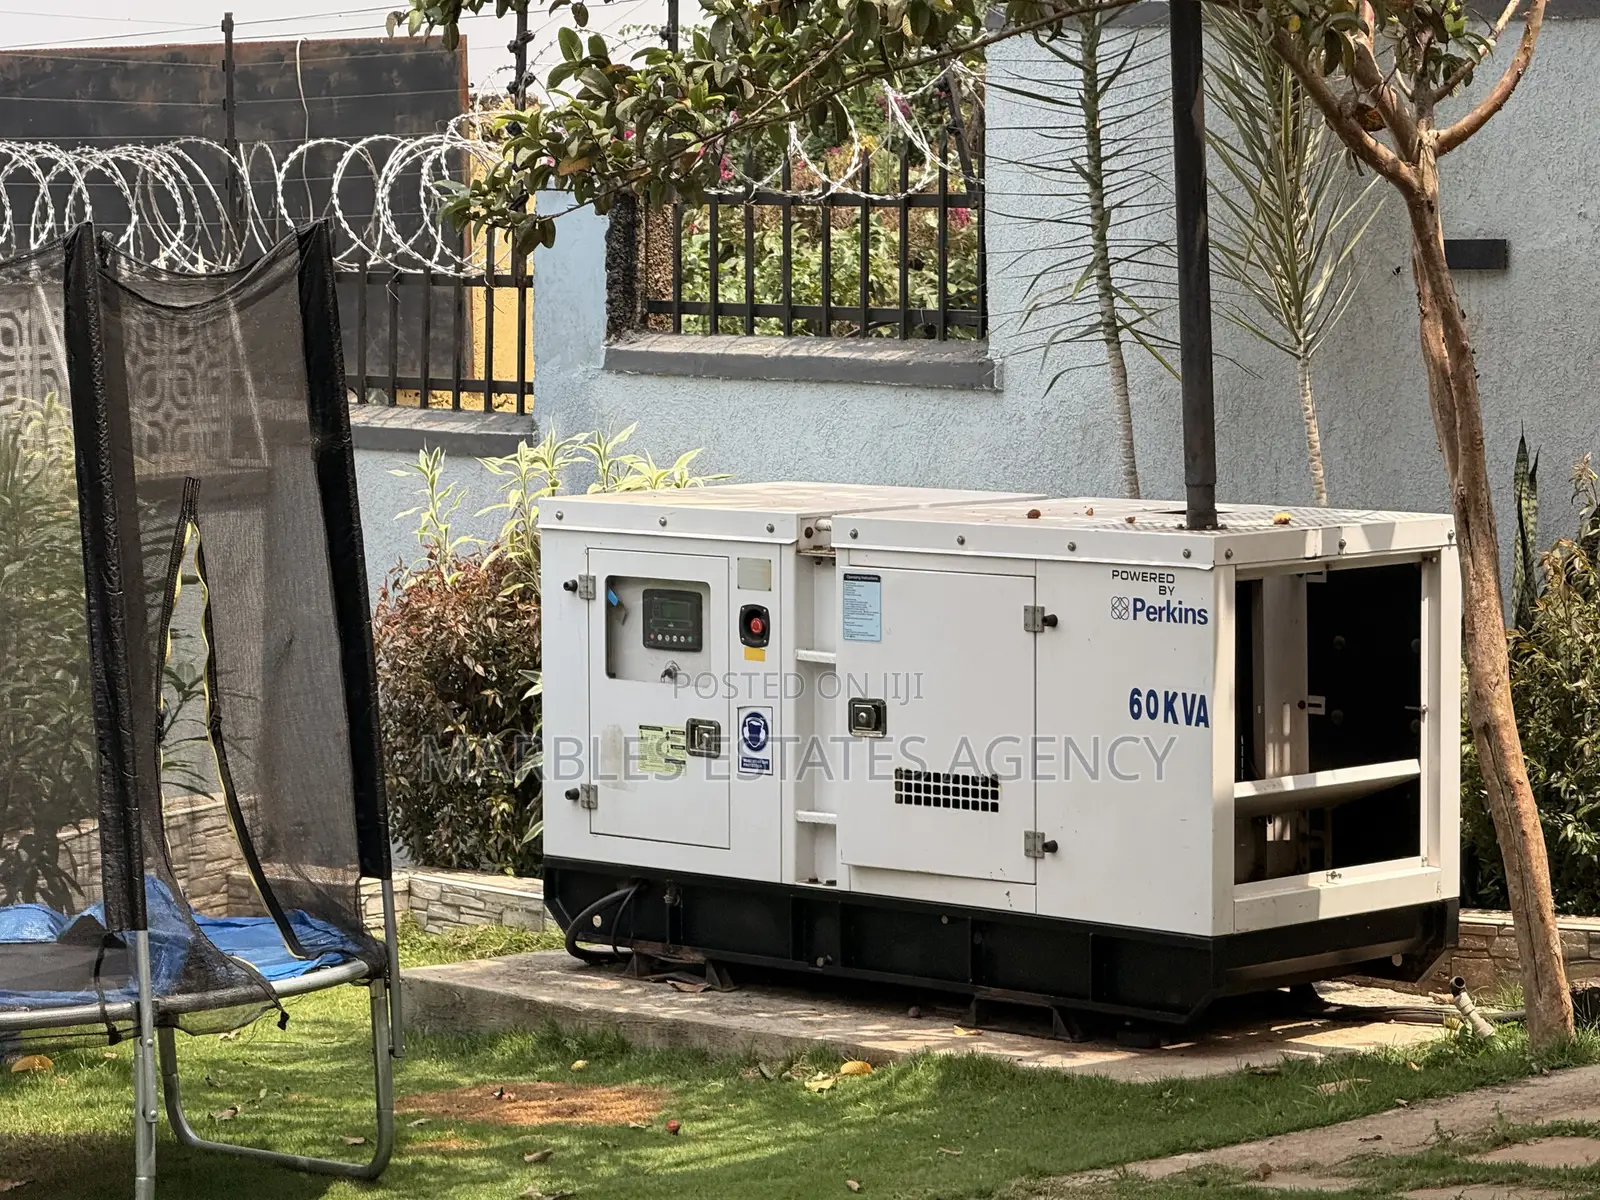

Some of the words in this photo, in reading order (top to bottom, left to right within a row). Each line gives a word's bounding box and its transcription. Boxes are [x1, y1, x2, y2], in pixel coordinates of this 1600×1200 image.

[1111, 569, 1175, 584] POWERED
[1158, 585, 1175, 596] BY
[1132, 597, 1209, 626] Perkins
[1129, 687, 1210, 728] 60KVA
